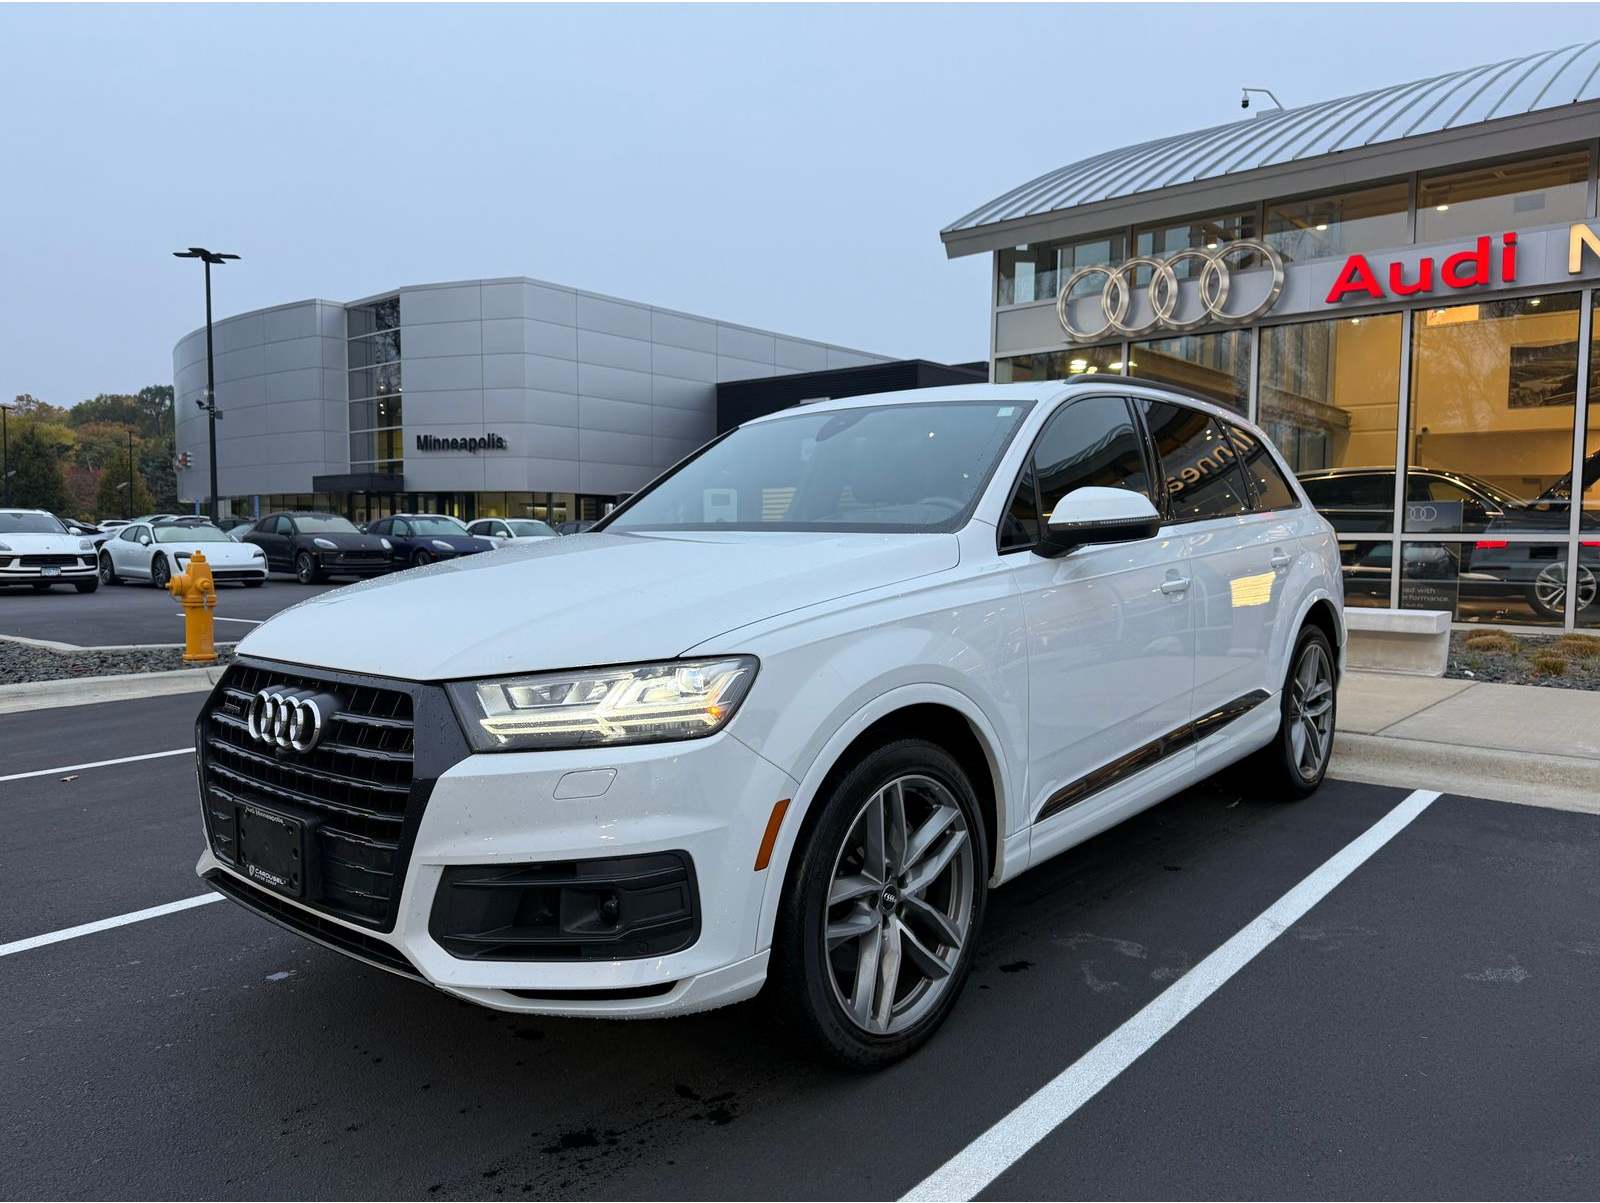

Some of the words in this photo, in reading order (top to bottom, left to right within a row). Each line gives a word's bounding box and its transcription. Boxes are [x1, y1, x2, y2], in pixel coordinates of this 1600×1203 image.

[1325, 231, 1518, 303] Audi
[416, 433, 505, 453] Minneapolis
[255, 868, 284, 885] CAROUSEL
